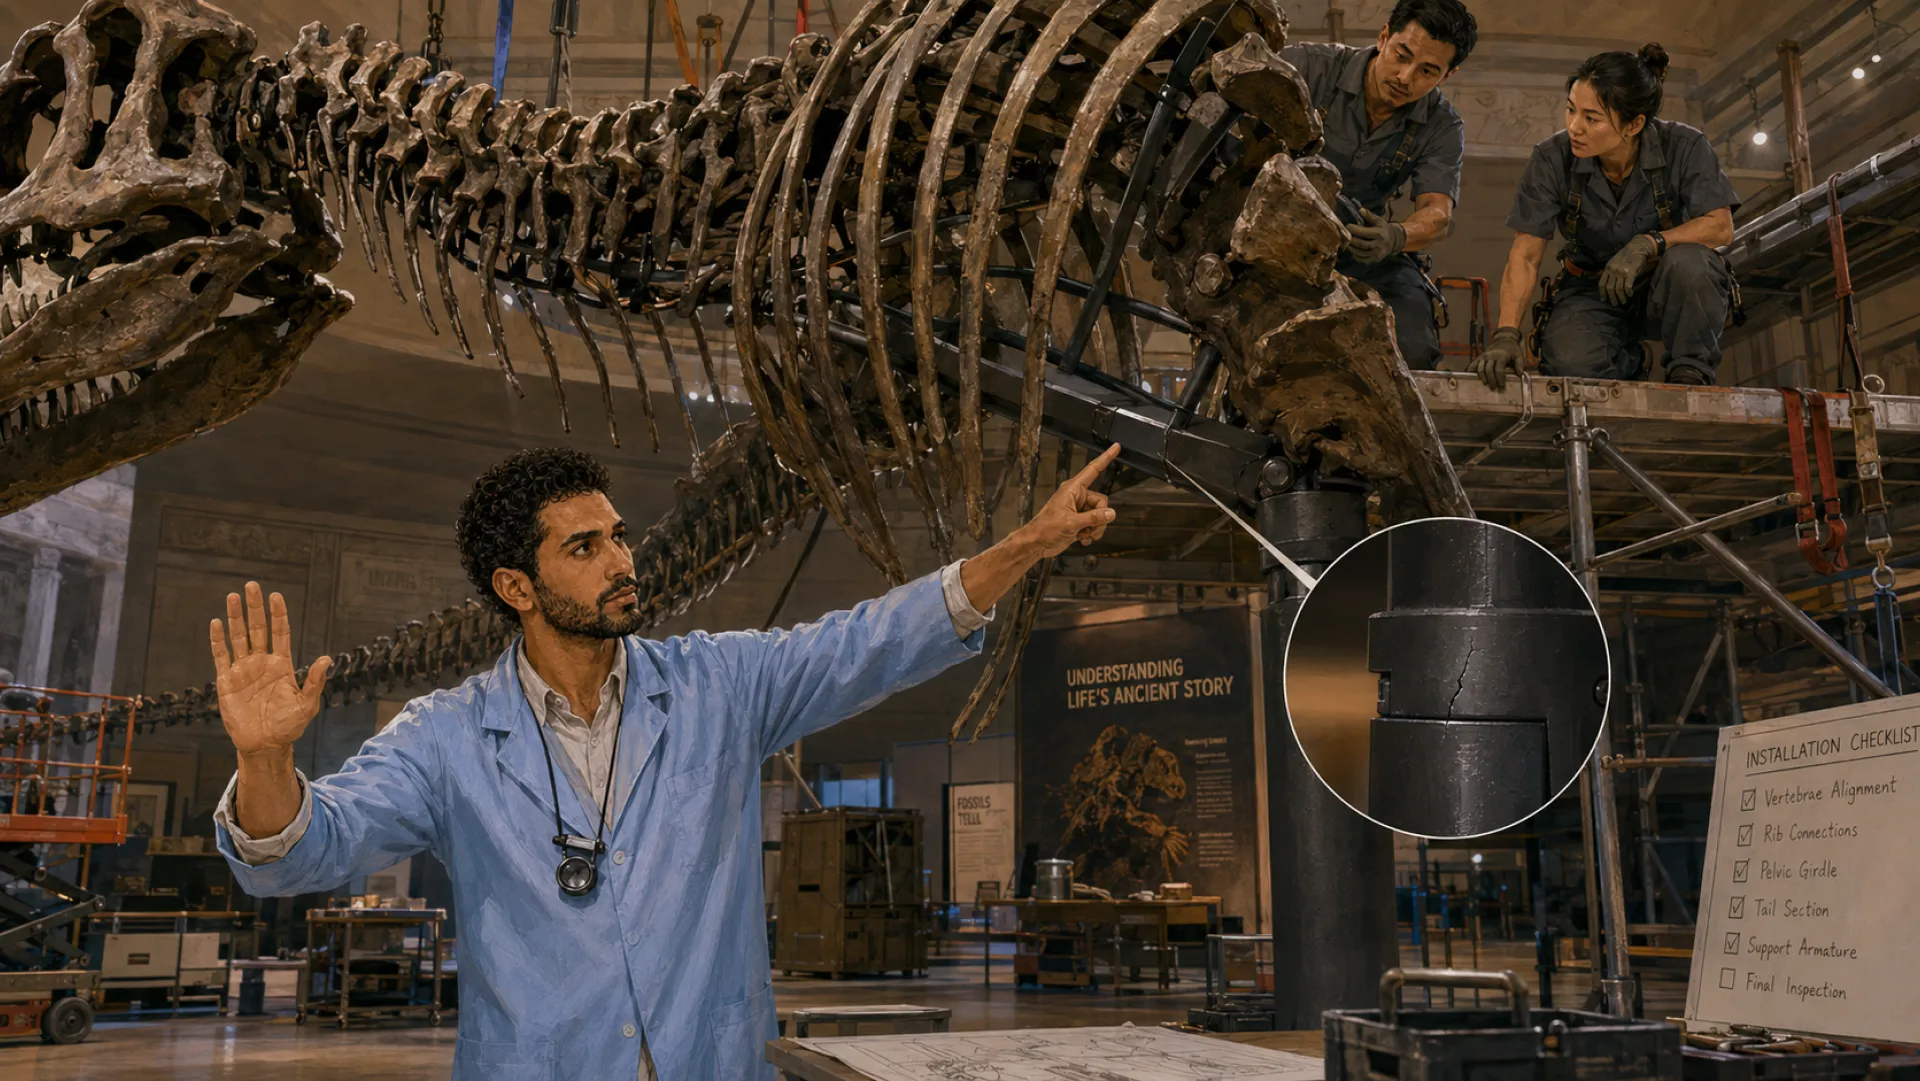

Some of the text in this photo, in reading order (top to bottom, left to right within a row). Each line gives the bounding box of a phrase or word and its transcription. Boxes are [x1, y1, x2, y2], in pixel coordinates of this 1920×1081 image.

[1067, 658, 1184, 686] UNDERSTANDING
[1067, 676, 1234, 709] LIFE'S ANCIENT STORY
[1746, 724, 1920, 768] INSTALLATION CHECKLIST
[957, 796, 991, 810] FOSSILS
[1764, 776, 1897, 807] Vertebrae Alignment
[1763, 822, 1858, 842] Rib Connections
[1760, 860, 1838, 880] Pelvic Girdle
[1755, 898, 1830, 917] Tail Section
[1747, 936, 1858, 960] Support Armature
[1746, 972, 1847, 1002] Final Inspection
